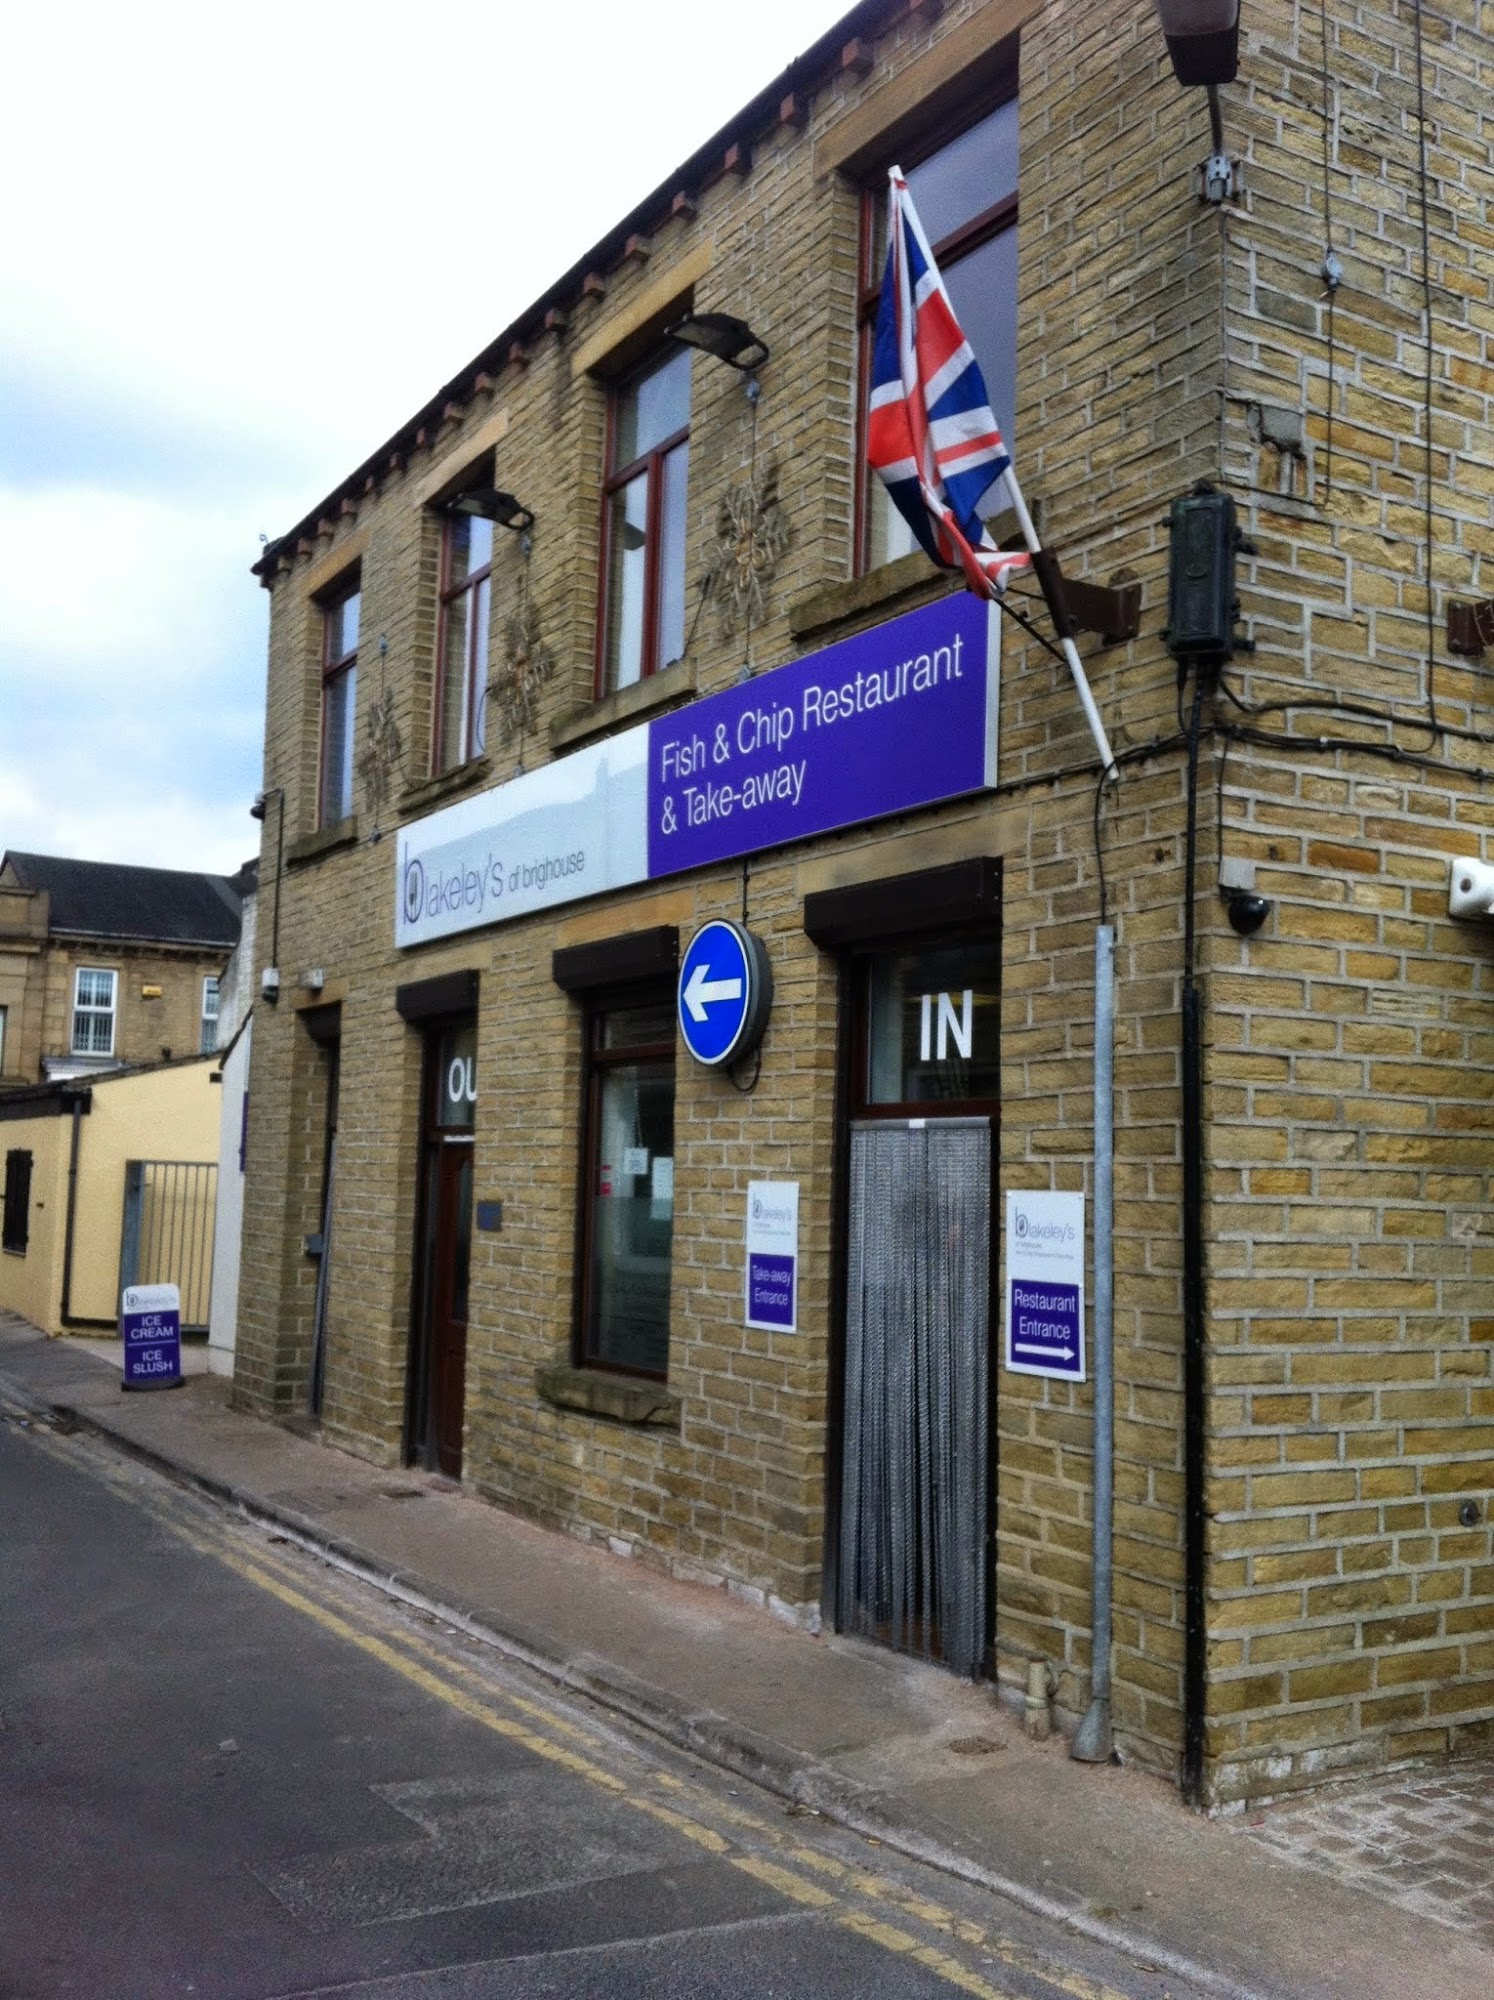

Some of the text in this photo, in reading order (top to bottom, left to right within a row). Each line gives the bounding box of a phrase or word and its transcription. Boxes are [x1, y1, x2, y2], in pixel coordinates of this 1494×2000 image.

[661, 633, 964, 782] Fish & Chip Restaurant
[661, 759, 807, 835] & Take-away
[508, 864, 522, 893] of
[524, 850, 586, 890] brighouse
[921, 989, 973, 1061] IN
[448, 1056, 478, 1102] OU
[753, 1264, 791, 1288] Take-away
[755, 1287, 788, 1307] Entrance
[1014, 1288, 1076, 1314] Restaurant
[130, 1327, 174, 1339] CREAM
[142, 1315, 162, 1326] ICE
[1019, 1316, 1071, 1341] Entrance
[132, 1361, 173, 1374] SLUSH
[142, 1350, 162, 1361] ICE
